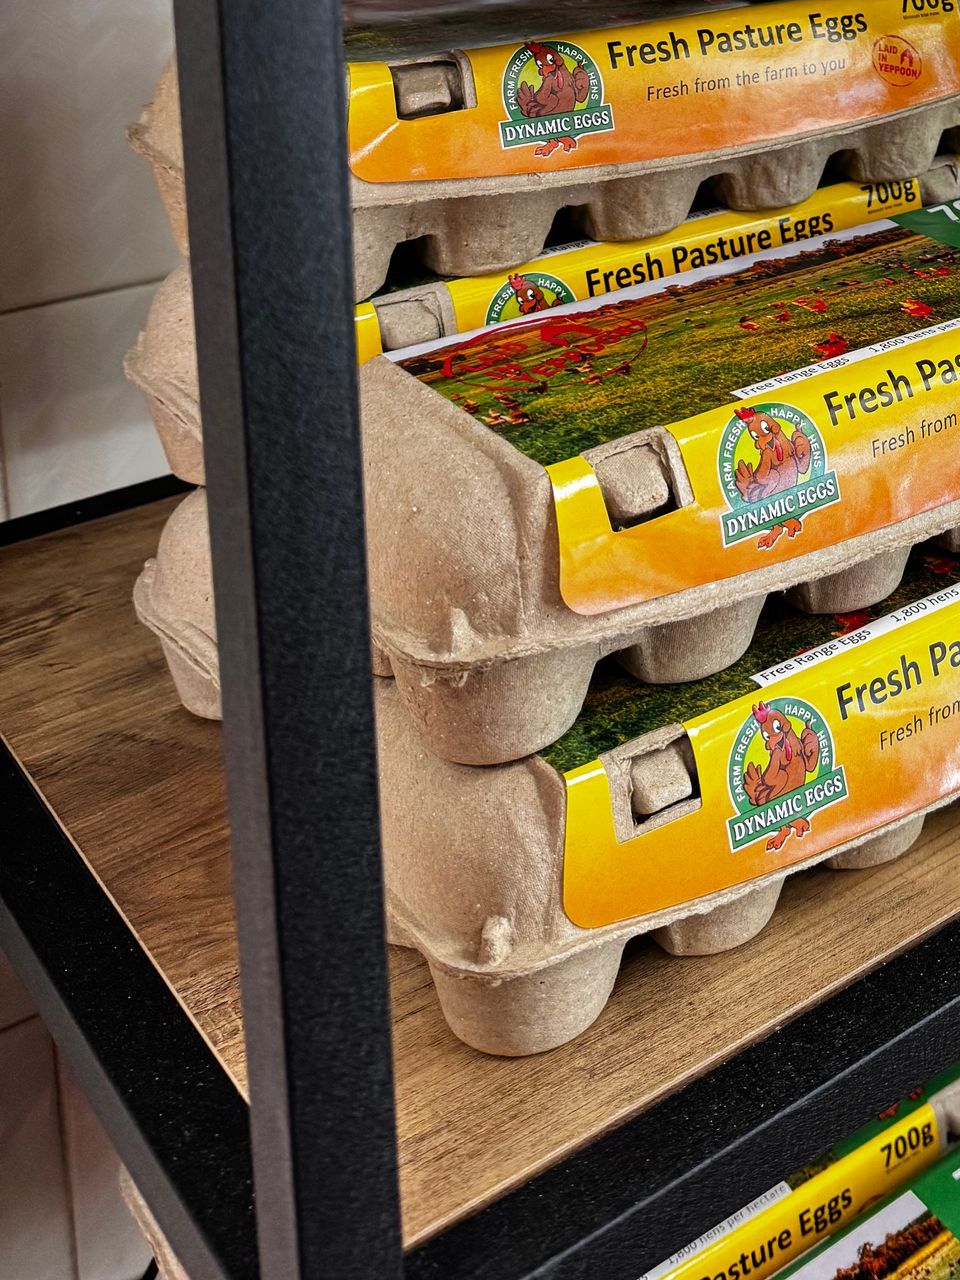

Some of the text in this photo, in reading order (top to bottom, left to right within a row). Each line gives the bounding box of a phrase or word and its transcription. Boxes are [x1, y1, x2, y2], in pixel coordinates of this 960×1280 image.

[607, 12, 868, 70] Fresh Pasture Eggs
[878, 43, 898, 54] LAID
[878, 52, 888, 62] IN
[507, 44, 599, 111] FARM FRESH HAPPY HENS
[647, 57, 846, 102] Fresh from the farm to you
[878, 63, 918, 78] YEPPOON
[504, 110, 610, 141] DYNAMIC EGGS
[860, 178, 917, 208] 700g
[585, 212, 834, 298] Fresh Pasture Eggs
[491, 277, 567, 319] FRESH HAPPY
[740, 380, 775, 398] Free
[777, 366, 818, 386] Range
[817, 355, 850, 372] Eggs
[868, 337, 904, 354] 1,800
[906, 329, 934, 343] hens
[932, 320, 958, 337] per
[824, 369, 914, 427] Fresh
[724, 408, 822, 498] FARM FRESH HAPPY HENS
[871, 426, 915, 459] Fresh
[919, 412, 958, 440] from
[726, 478, 835, 537] DYNAMIC EGGS
[760, 662, 795, 682] Free
[796, 642, 840, 666] Range
[840, 626, 872, 645] Eggs
[890, 601, 928, 623] 1,800
[929, 588, 959, 605] hens
[836, 655, 923, 720] Fresh
[732, 704, 830, 802] FARM FRESH HAPPY HENS
[880, 718, 923, 751] Fresh
[733, 775, 843, 841] DYNAMIC EGGS
[880, 1121, 934, 1169] 700g
[798, 1187, 853, 1236] Eggs
